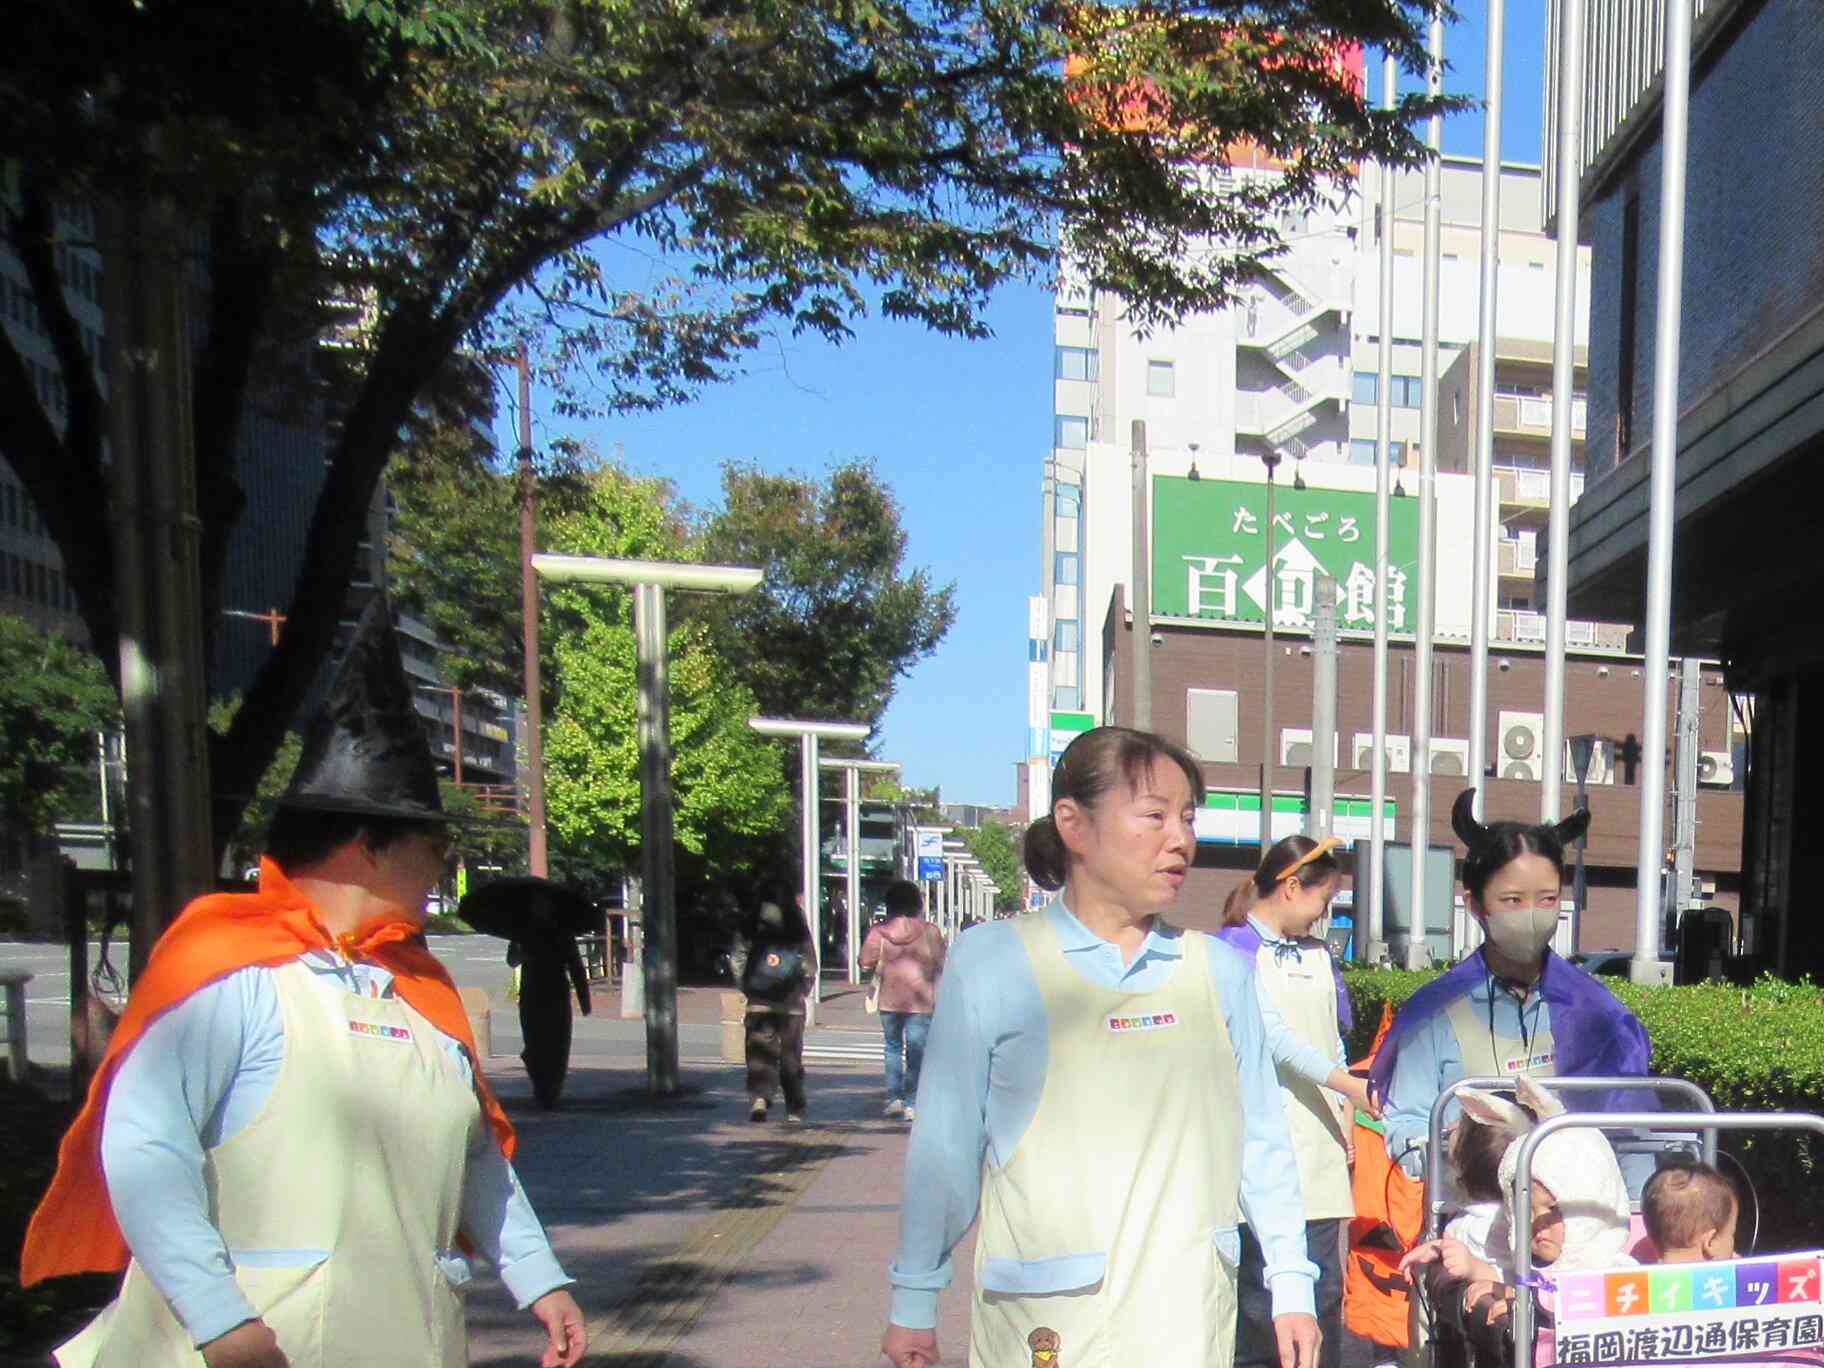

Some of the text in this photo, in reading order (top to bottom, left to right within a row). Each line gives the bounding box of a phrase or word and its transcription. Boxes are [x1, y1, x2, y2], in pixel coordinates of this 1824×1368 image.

[1232, 506, 1360, 542] たべごろ
[1566, 1268, 1817, 1313] ニチイキッズ
[1557, 1313, 1824, 1364] 福岡渡辺通保育園
